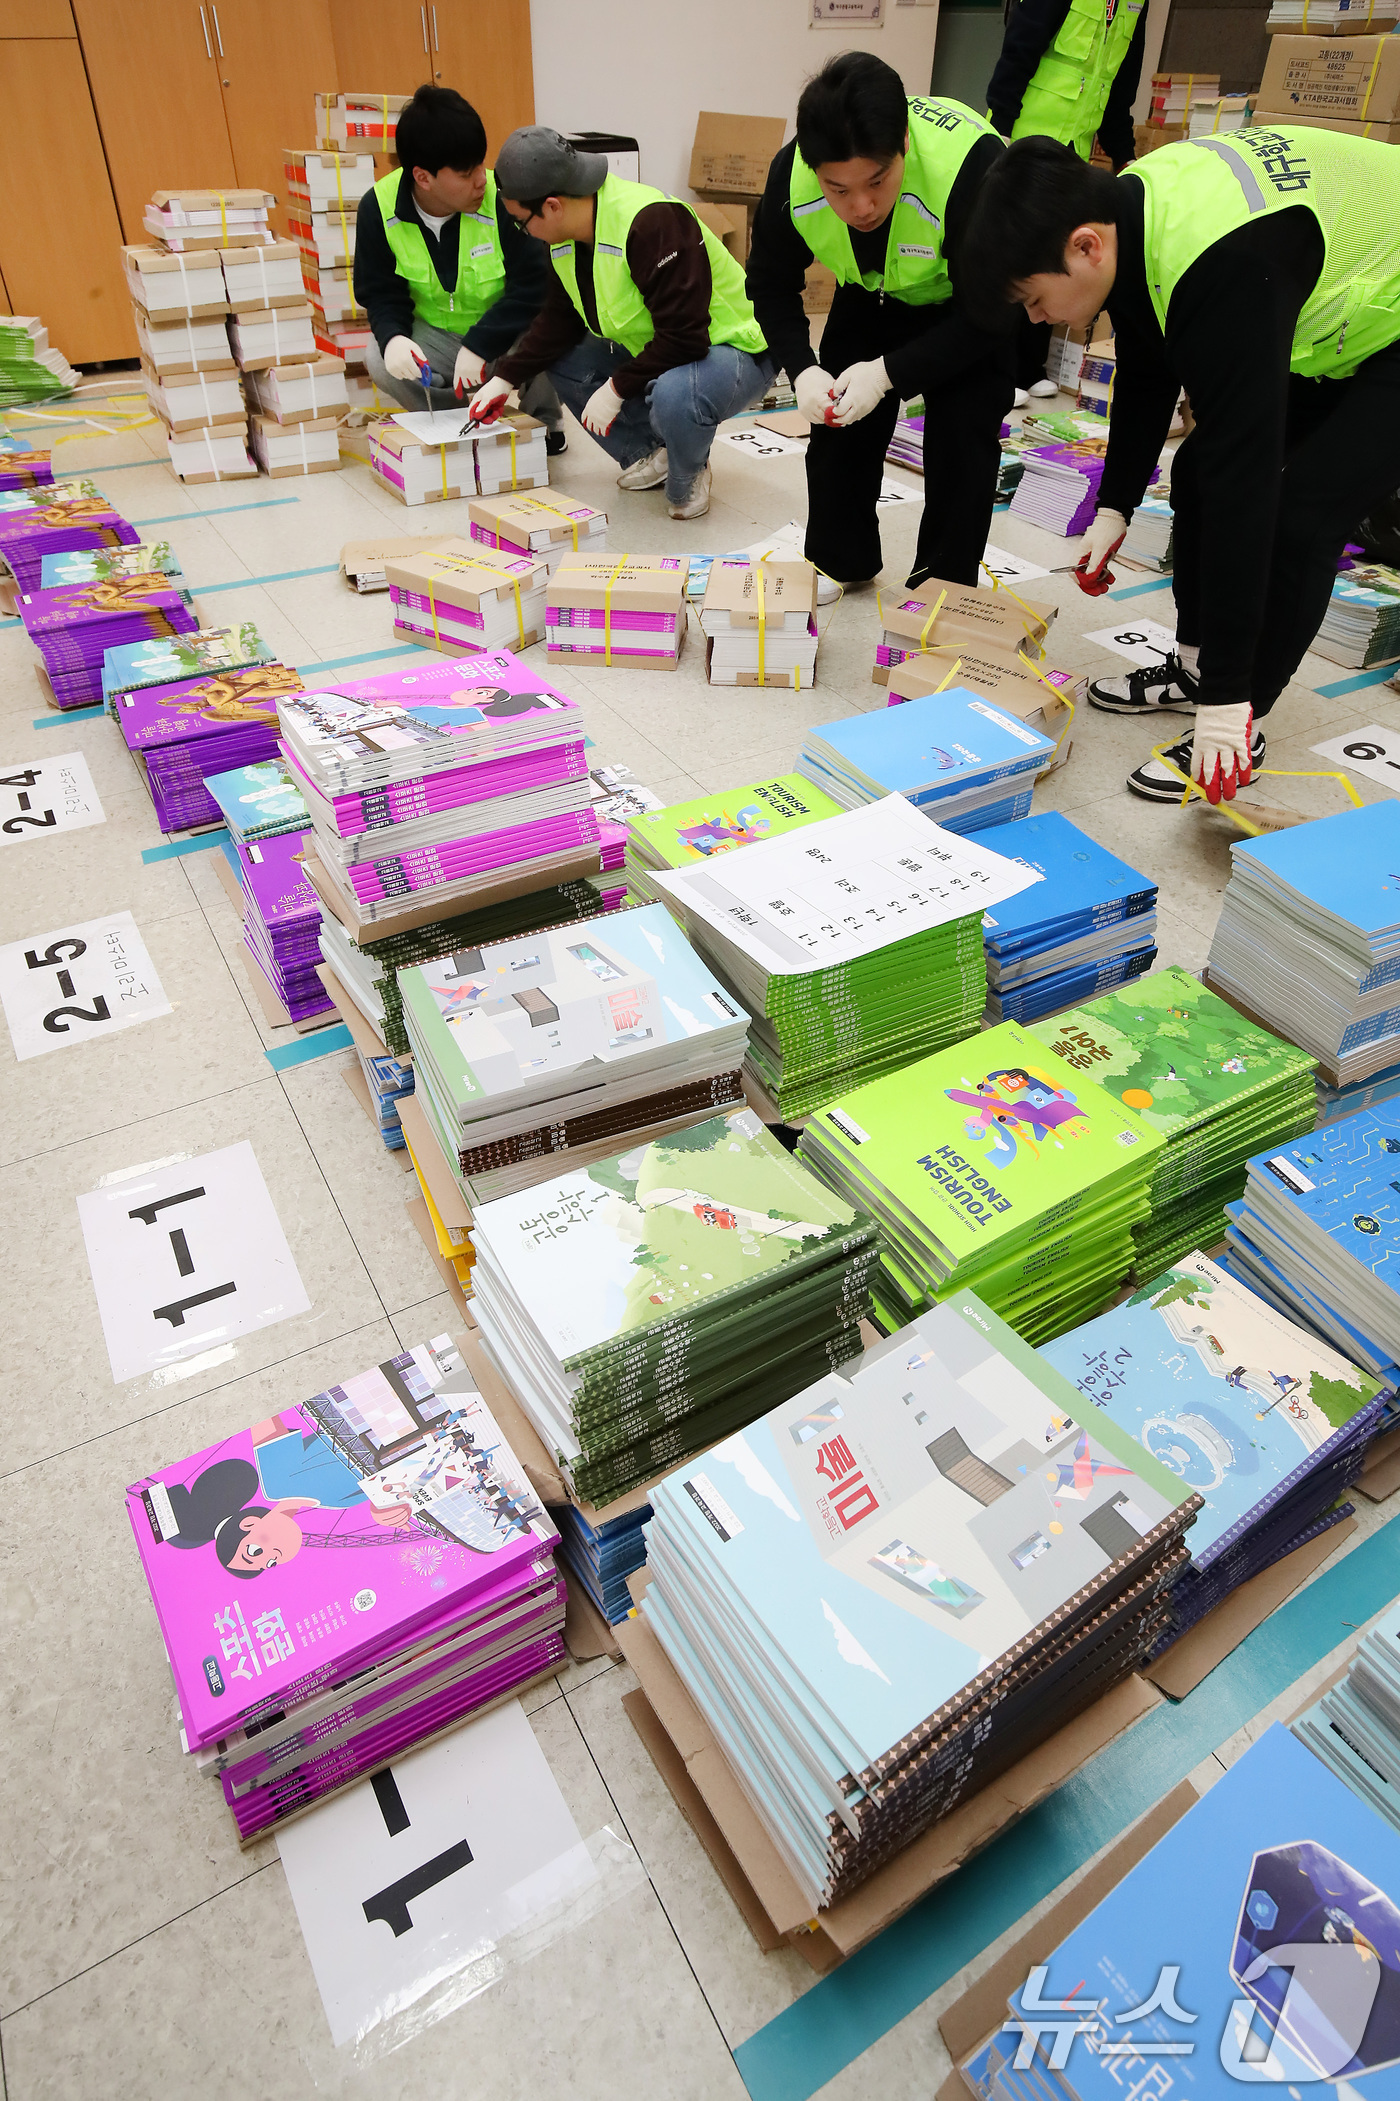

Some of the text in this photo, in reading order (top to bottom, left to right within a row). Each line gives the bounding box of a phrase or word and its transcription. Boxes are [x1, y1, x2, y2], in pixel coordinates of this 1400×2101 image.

[1318, 50, 1354, 61] 고등(22개정)
[0, 769, 57, 834] 2-4
[753, 786, 797, 819] ENGLISH
[767, 782, 811, 816] TOURISM
[804, 847, 832, 865] 24명
[835, 879, 861, 895] 조리
[929, 885, 950, 899] 1-7
[949, 877, 971, 891] 1-8
[970, 869, 992, 884] 1-9
[886, 900, 908, 914] 1-5
[907, 892, 928, 906] 1-6
[728, 906, 759, 926] 1학년
[843, 915, 864, 930] 1-3
[865, 908, 886, 922] 1-4
[797, 931, 819, 947] 1-1
[820, 923, 842, 939] 1-2
[103, 930, 150, 1002] 조리마스터
[24, 937, 112, 1033] 2-5
[608, 988, 645, 1032] 미술
[916, 1154, 994, 1227] TOURISM
[935, 1144, 1013, 1214] ENGLISH
[556, 1190, 595, 1223] 수학
[947, 1203, 968, 1223] SCHOOL
[519, 1210, 569, 1245] 공통
[964, 1219, 977, 1233] HIGH
[127, 1185, 238, 1328] 1-1
[962, 1304, 992, 1333] MiraeN
[815, 1433, 880, 1532] 미술
[815, 1496, 844, 1541] 고등학교
[213, 1599, 263, 1682] 스포츠
[251, 1607, 297, 1669] 문화
[361, 1767, 475, 1938] 1-
